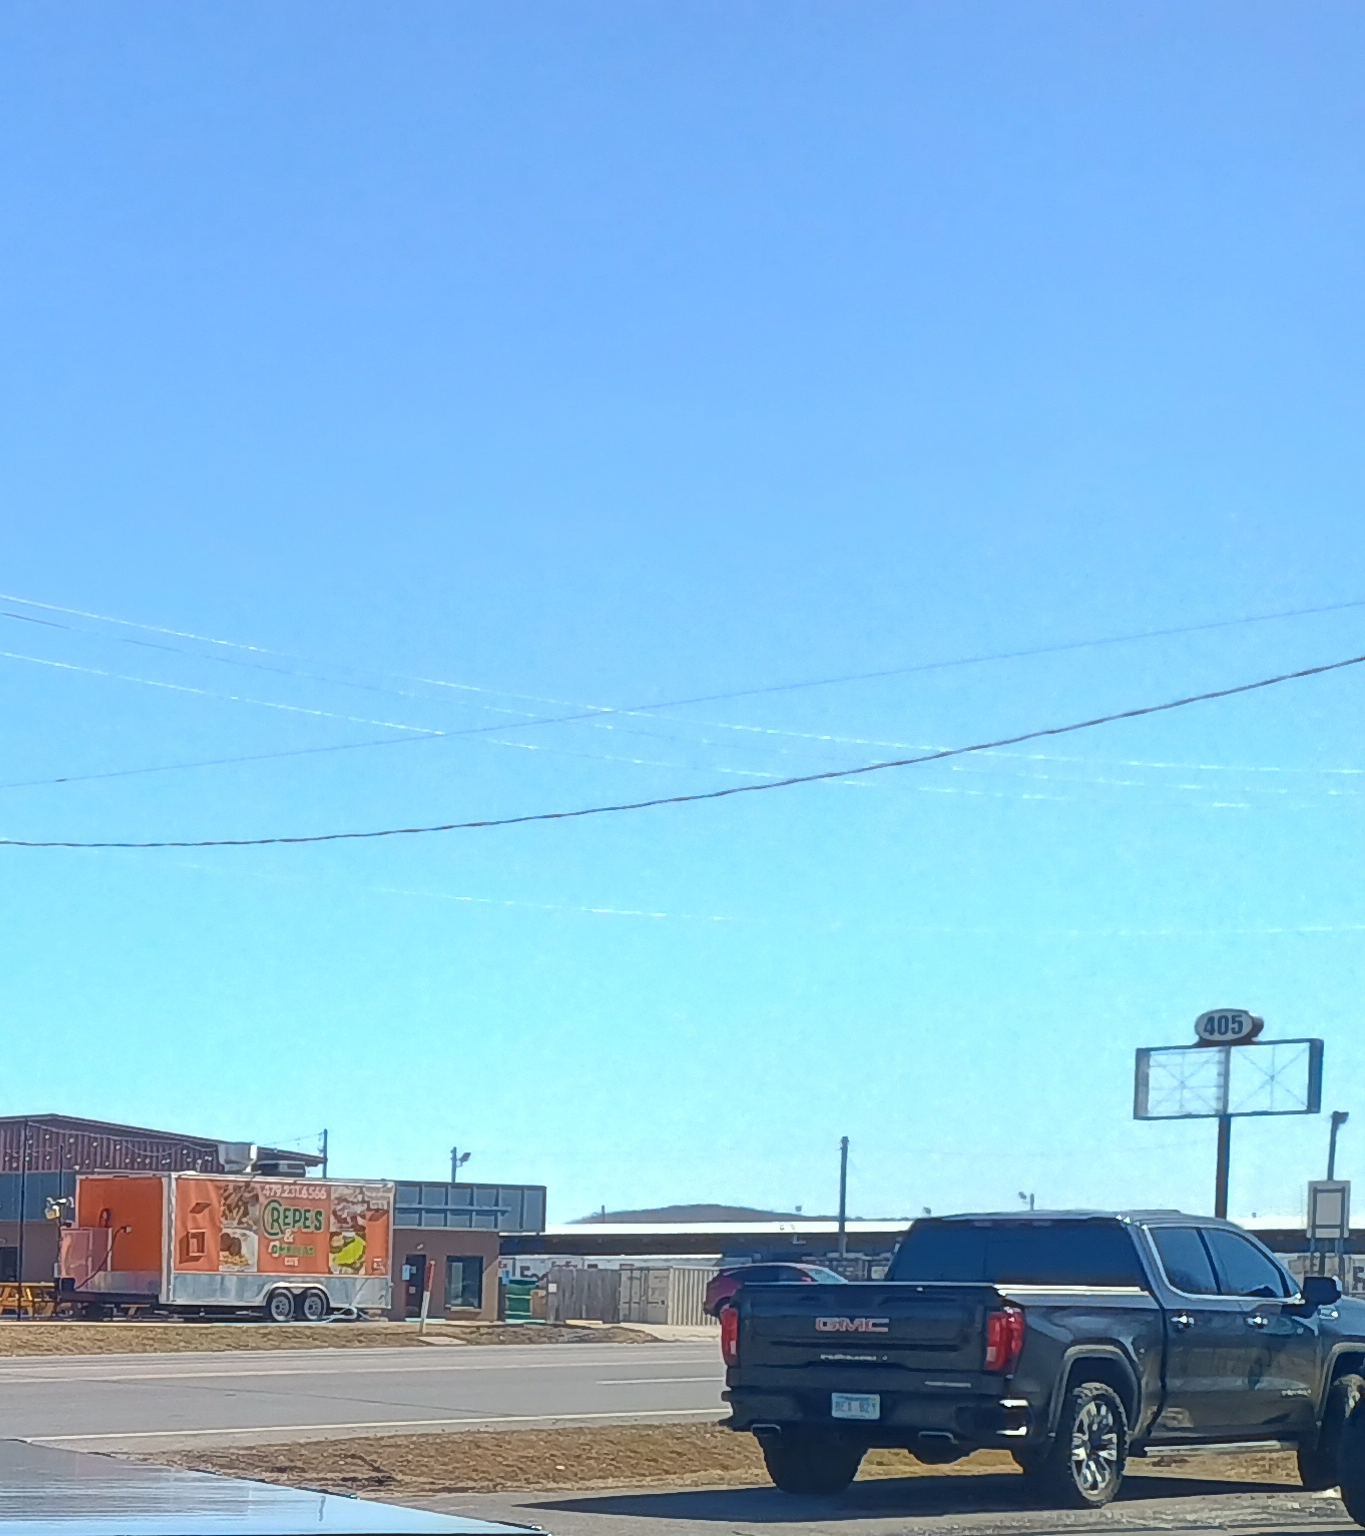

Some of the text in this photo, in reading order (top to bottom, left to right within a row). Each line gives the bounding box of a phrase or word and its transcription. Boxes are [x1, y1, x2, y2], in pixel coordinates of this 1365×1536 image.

[1202, 1013, 1244, 1036] 405
[261, 1198, 325, 1238] CREPES
[814, 1316, 890, 1333] GMC
